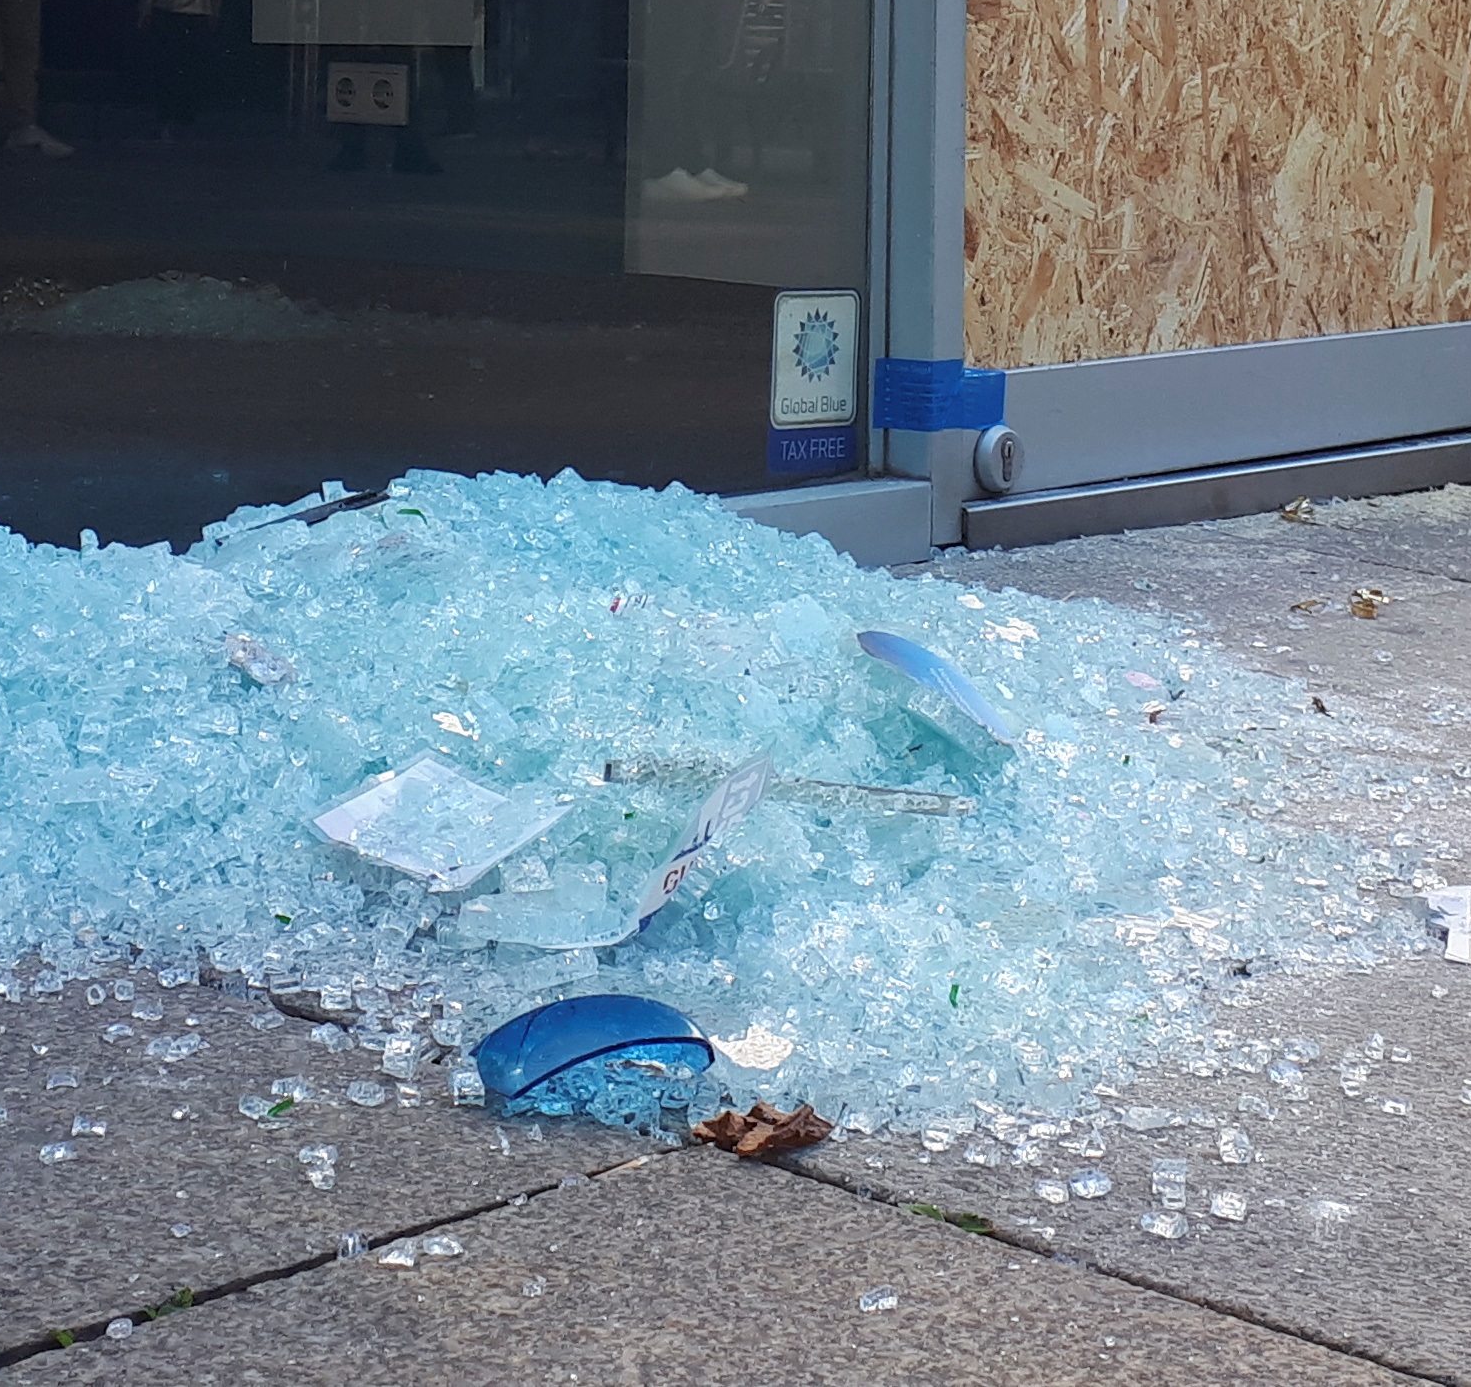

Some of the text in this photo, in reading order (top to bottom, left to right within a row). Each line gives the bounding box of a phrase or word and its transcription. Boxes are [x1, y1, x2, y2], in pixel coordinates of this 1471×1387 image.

[781, 396, 847, 414] Global Blue
[781, 437, 845, 461] TAX FREE
